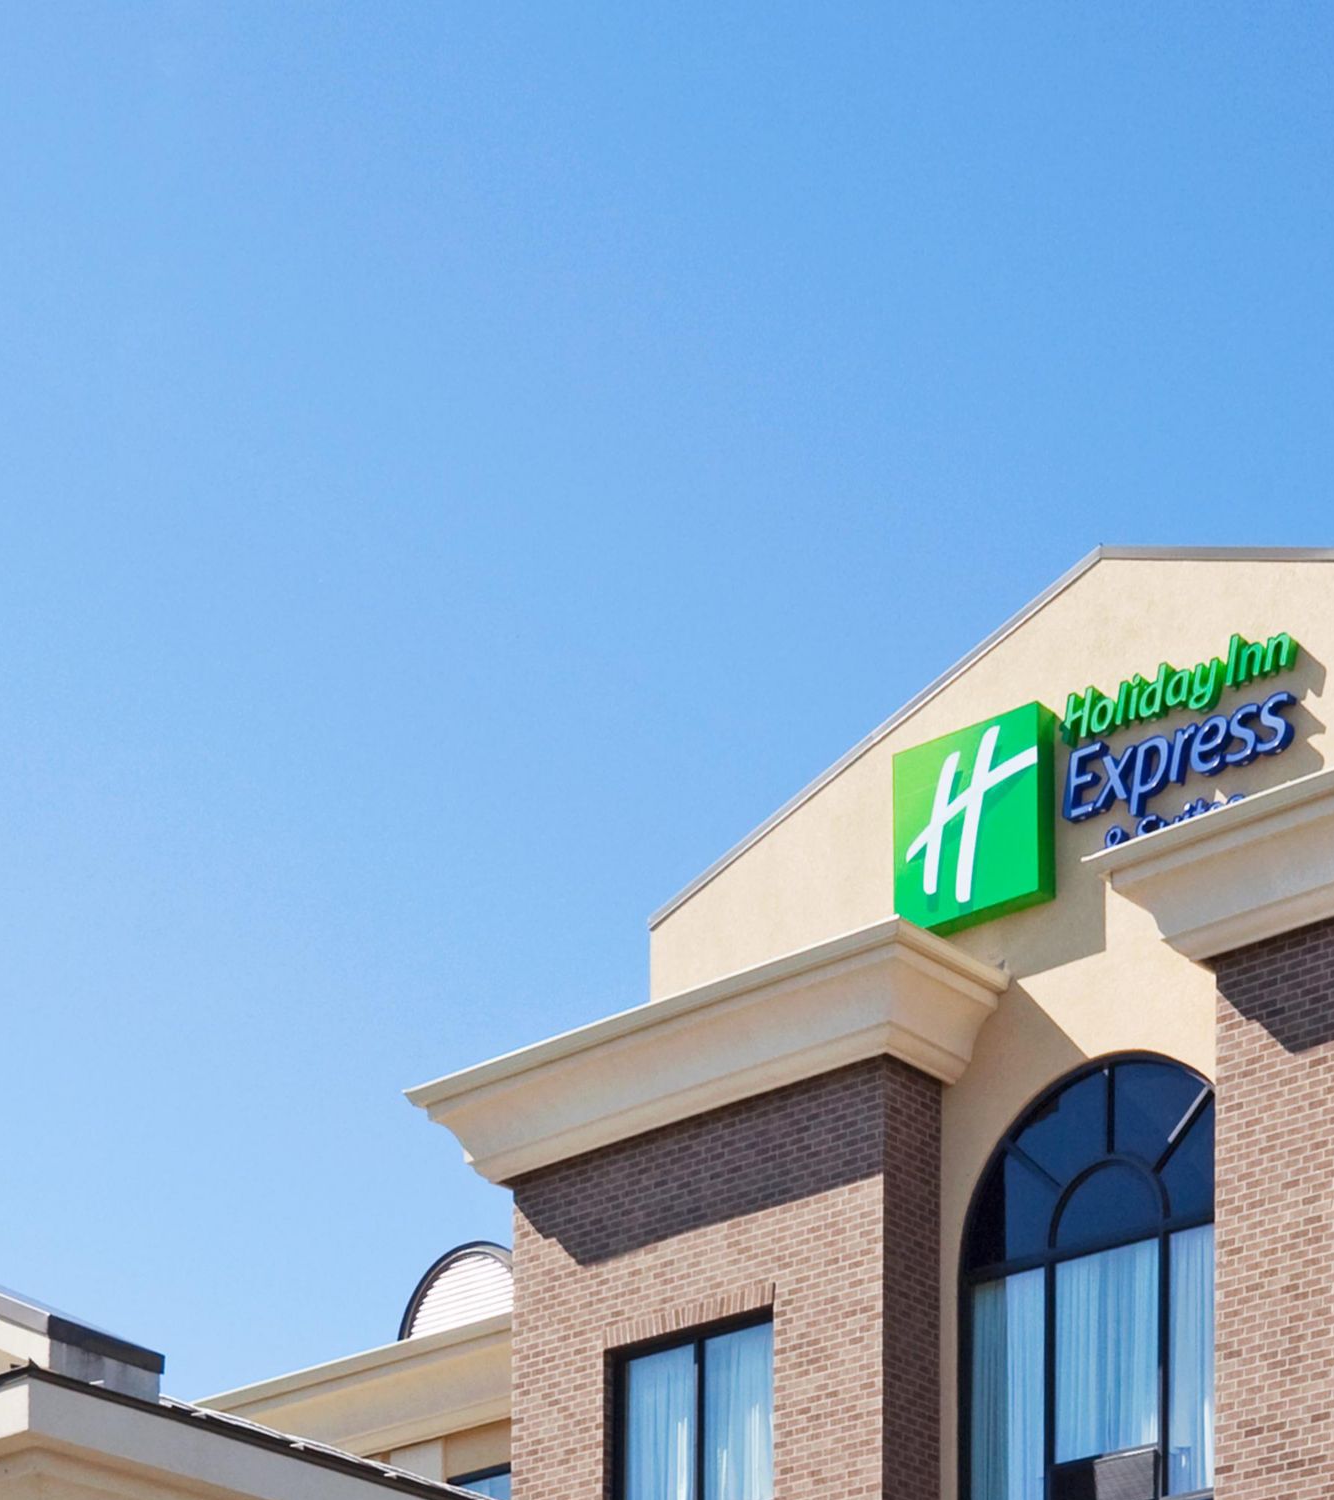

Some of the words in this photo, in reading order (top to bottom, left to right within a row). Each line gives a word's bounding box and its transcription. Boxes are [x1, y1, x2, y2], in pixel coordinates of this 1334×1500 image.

[1062, 657, 1222, 744] Holiday
[1225, 632, 1296, 689] Inn
[1064, 692, 1296, 822] Express
